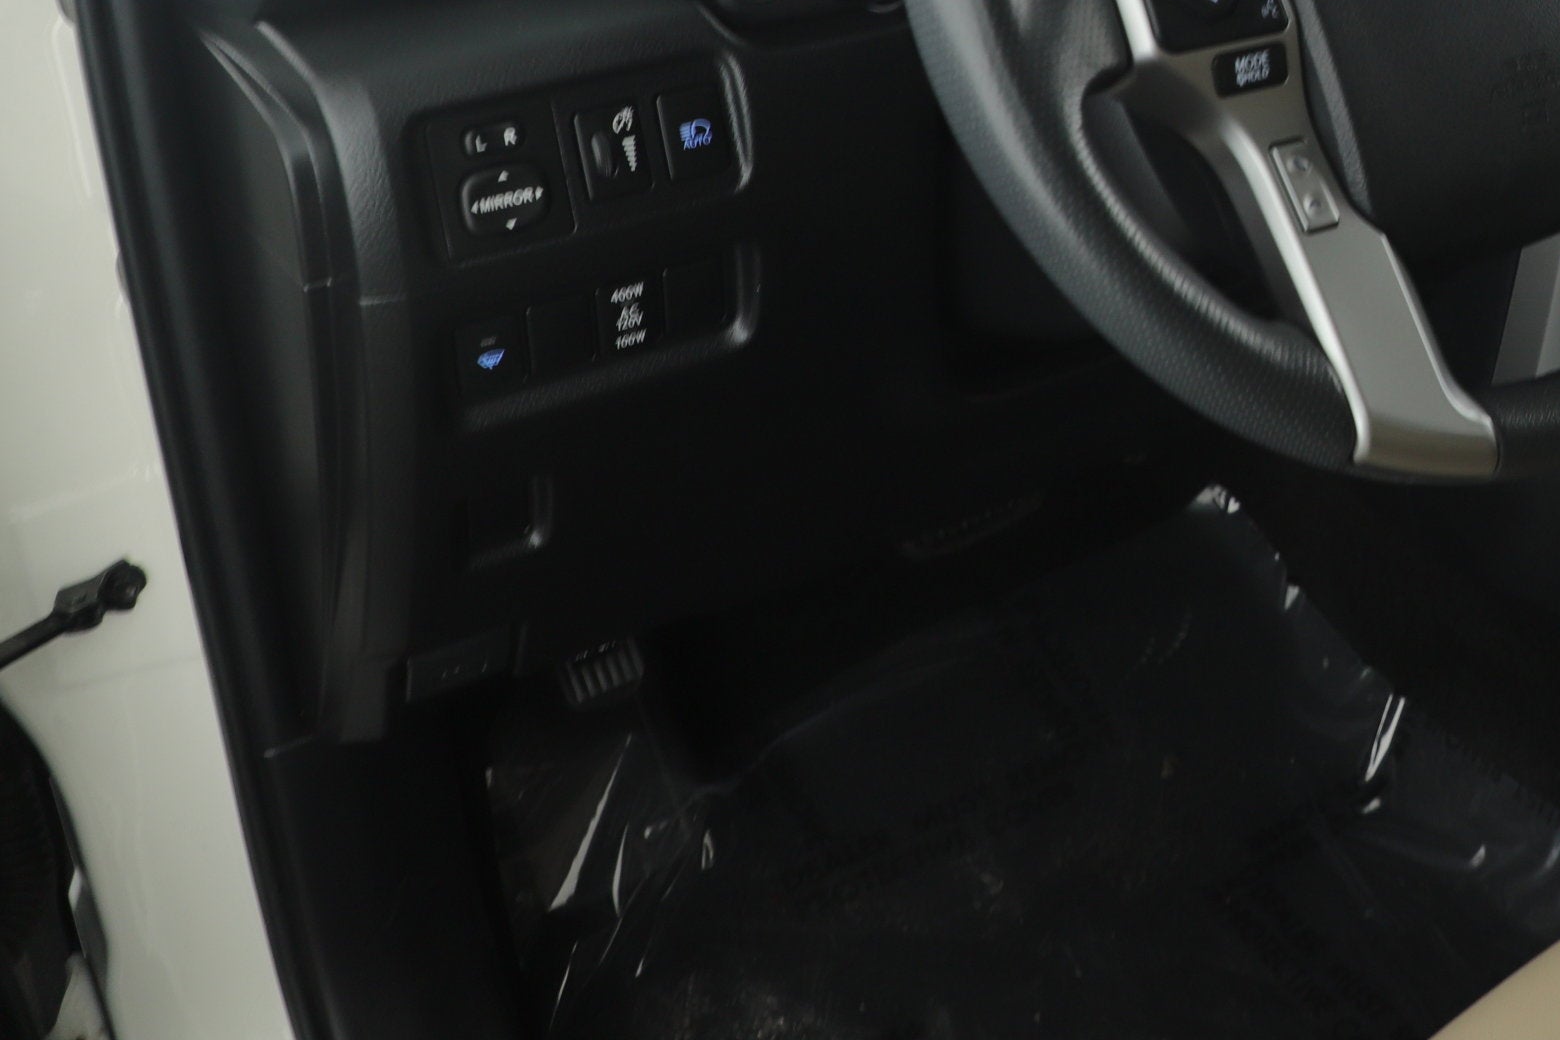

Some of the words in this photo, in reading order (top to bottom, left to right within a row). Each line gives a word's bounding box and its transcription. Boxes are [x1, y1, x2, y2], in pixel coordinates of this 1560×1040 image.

[1235, 49, 1270, 73] MODE
[475, 135, 487, 153] L
[503, 127, 517, 147] R
[683, 132, 712, 150] AUTO
[480, 186, 535, 214] MIRROR
